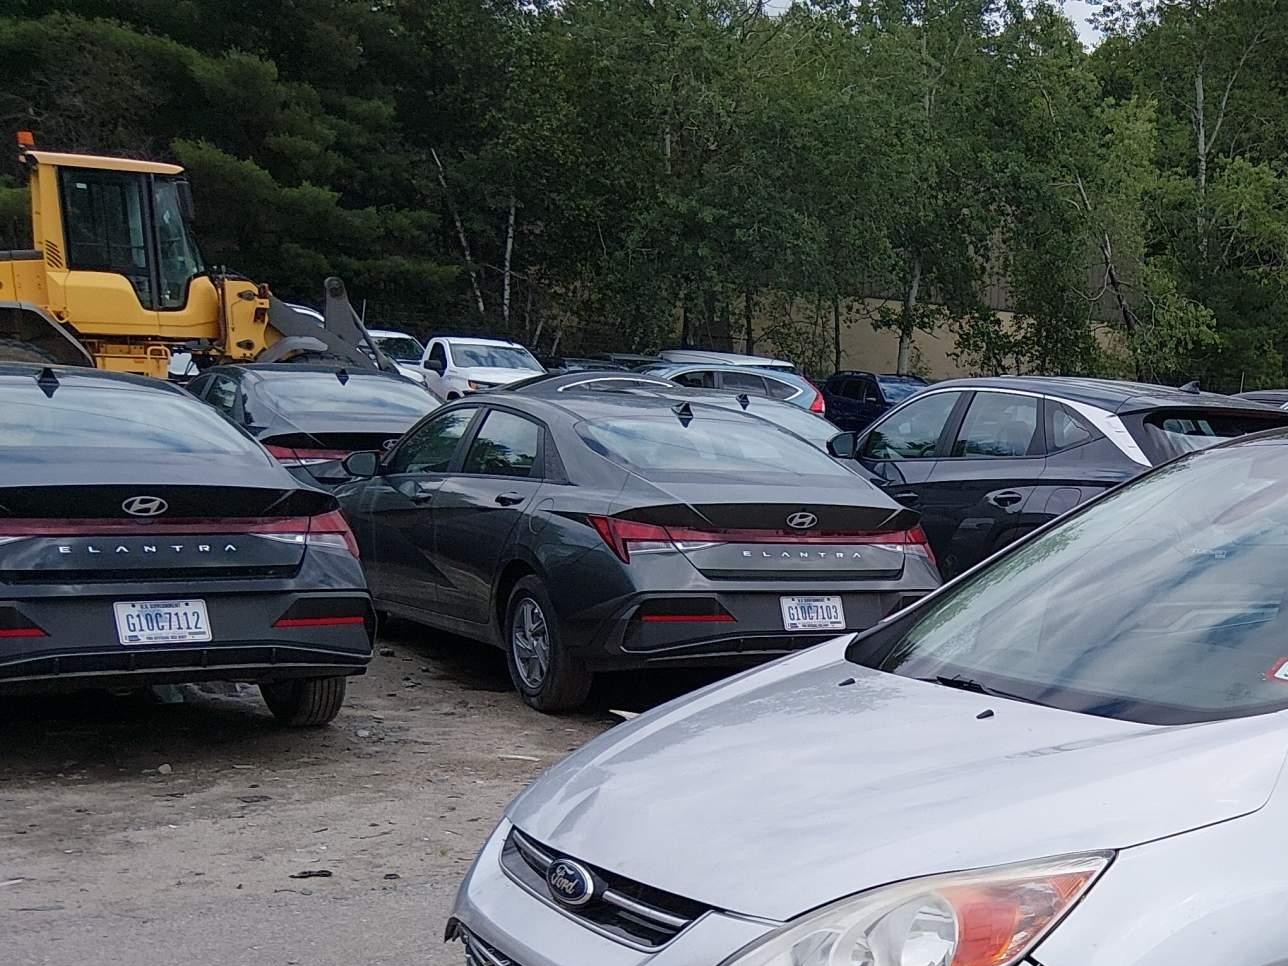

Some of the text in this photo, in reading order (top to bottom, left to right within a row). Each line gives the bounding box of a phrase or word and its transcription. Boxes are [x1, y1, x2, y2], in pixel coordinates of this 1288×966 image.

[59, 544, 238, 553] ELANTRA
[743, 550, 862, 558] ELANTRA
[126, 611, 202, 632] G10C7112
[551, 864, 579, 894] Ford
